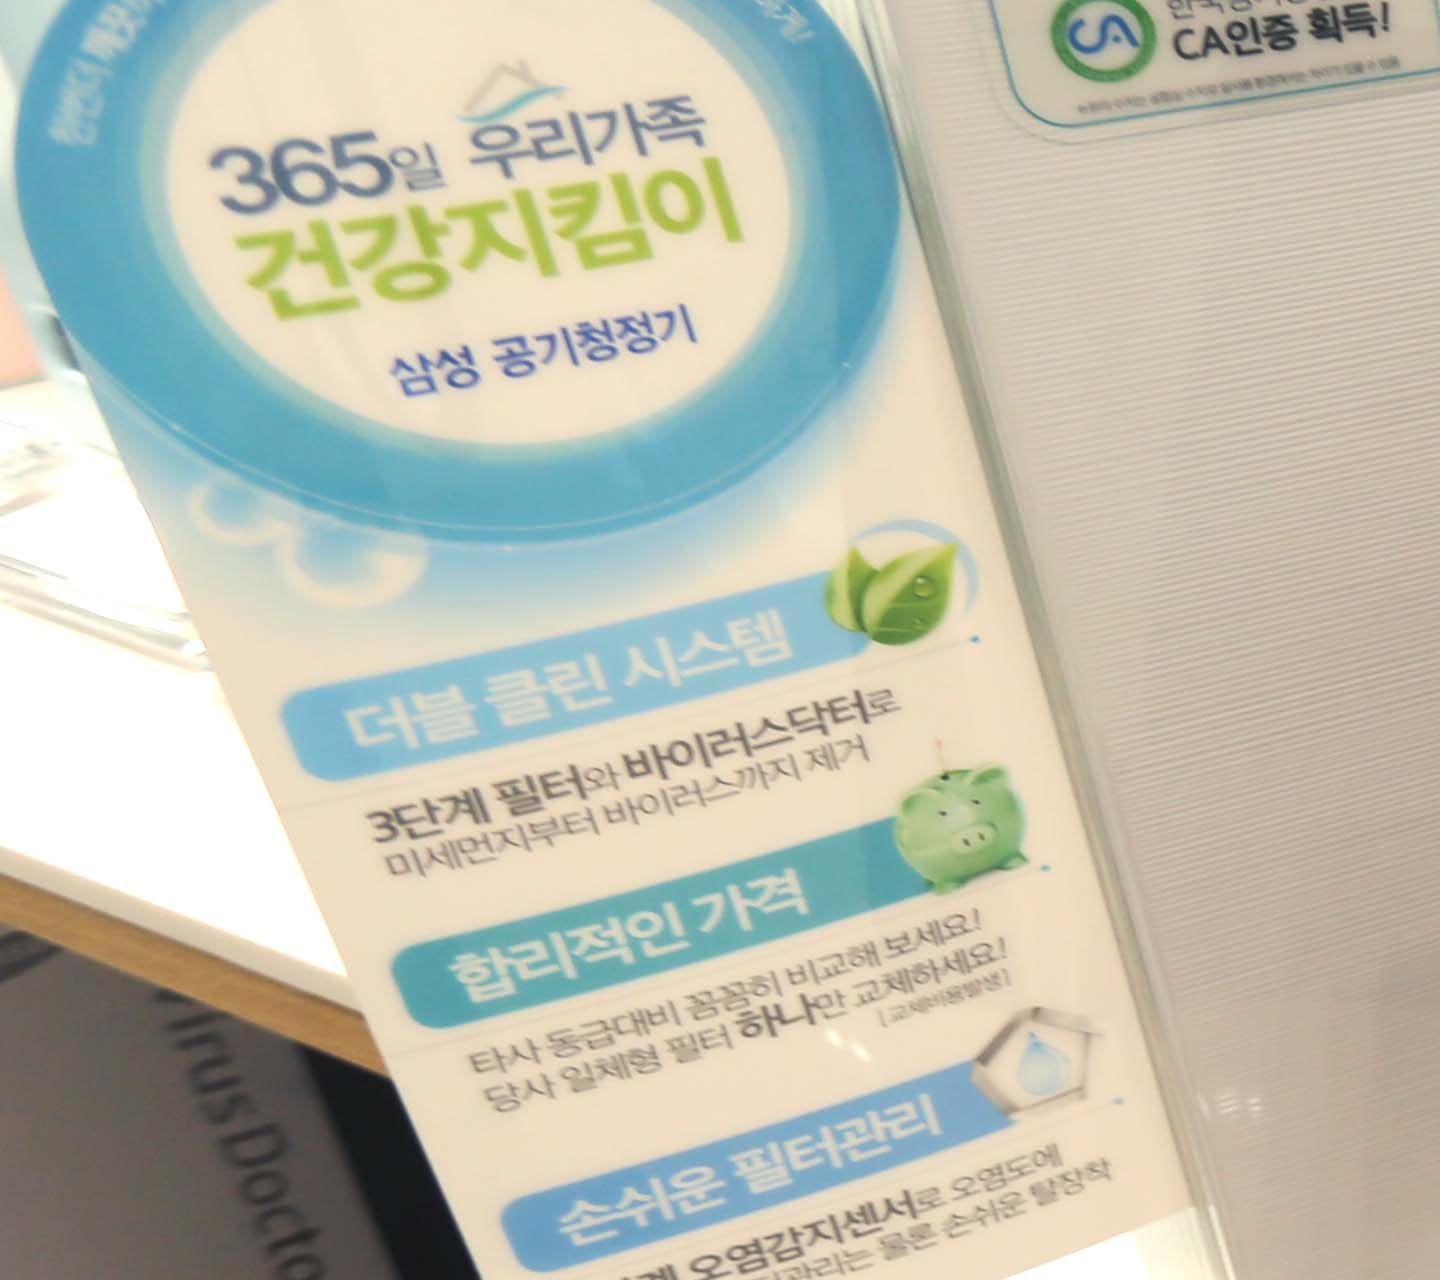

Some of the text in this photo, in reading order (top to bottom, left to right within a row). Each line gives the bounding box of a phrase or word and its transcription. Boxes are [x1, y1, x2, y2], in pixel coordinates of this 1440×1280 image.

[1173, 1, 1391, 62] CA인증 획득!
[207, 93, 707, 216] 365일 우리가족
[233, 155, 746, 321] 건강지킴이
[387, 302, 698, 397] 삼성 공기청정기
[344, 609, 794, 750] 더블 클린 시스템
[366, 686, 901, 845] 3단계 필터와 바이러스닥터로
[383, 734, 870, 879] 미세먼지부터 바이러스까지 제거
[447, 867, 811, 1004] 합리적인 가격
[469, 908, 983, 1077] 타사 동급대비 꼼꼼히 비교해 보세요!
[483, 937, 1008, 1114] 당사 일체형 필터 하나만 교체하세요!
[556, 1094, 944, 1248] 손쉬운 필터관리
[688, 1186, 947, 1279] 오염감지센서로
[950, 1142, 1061, 1200] 오염도에
